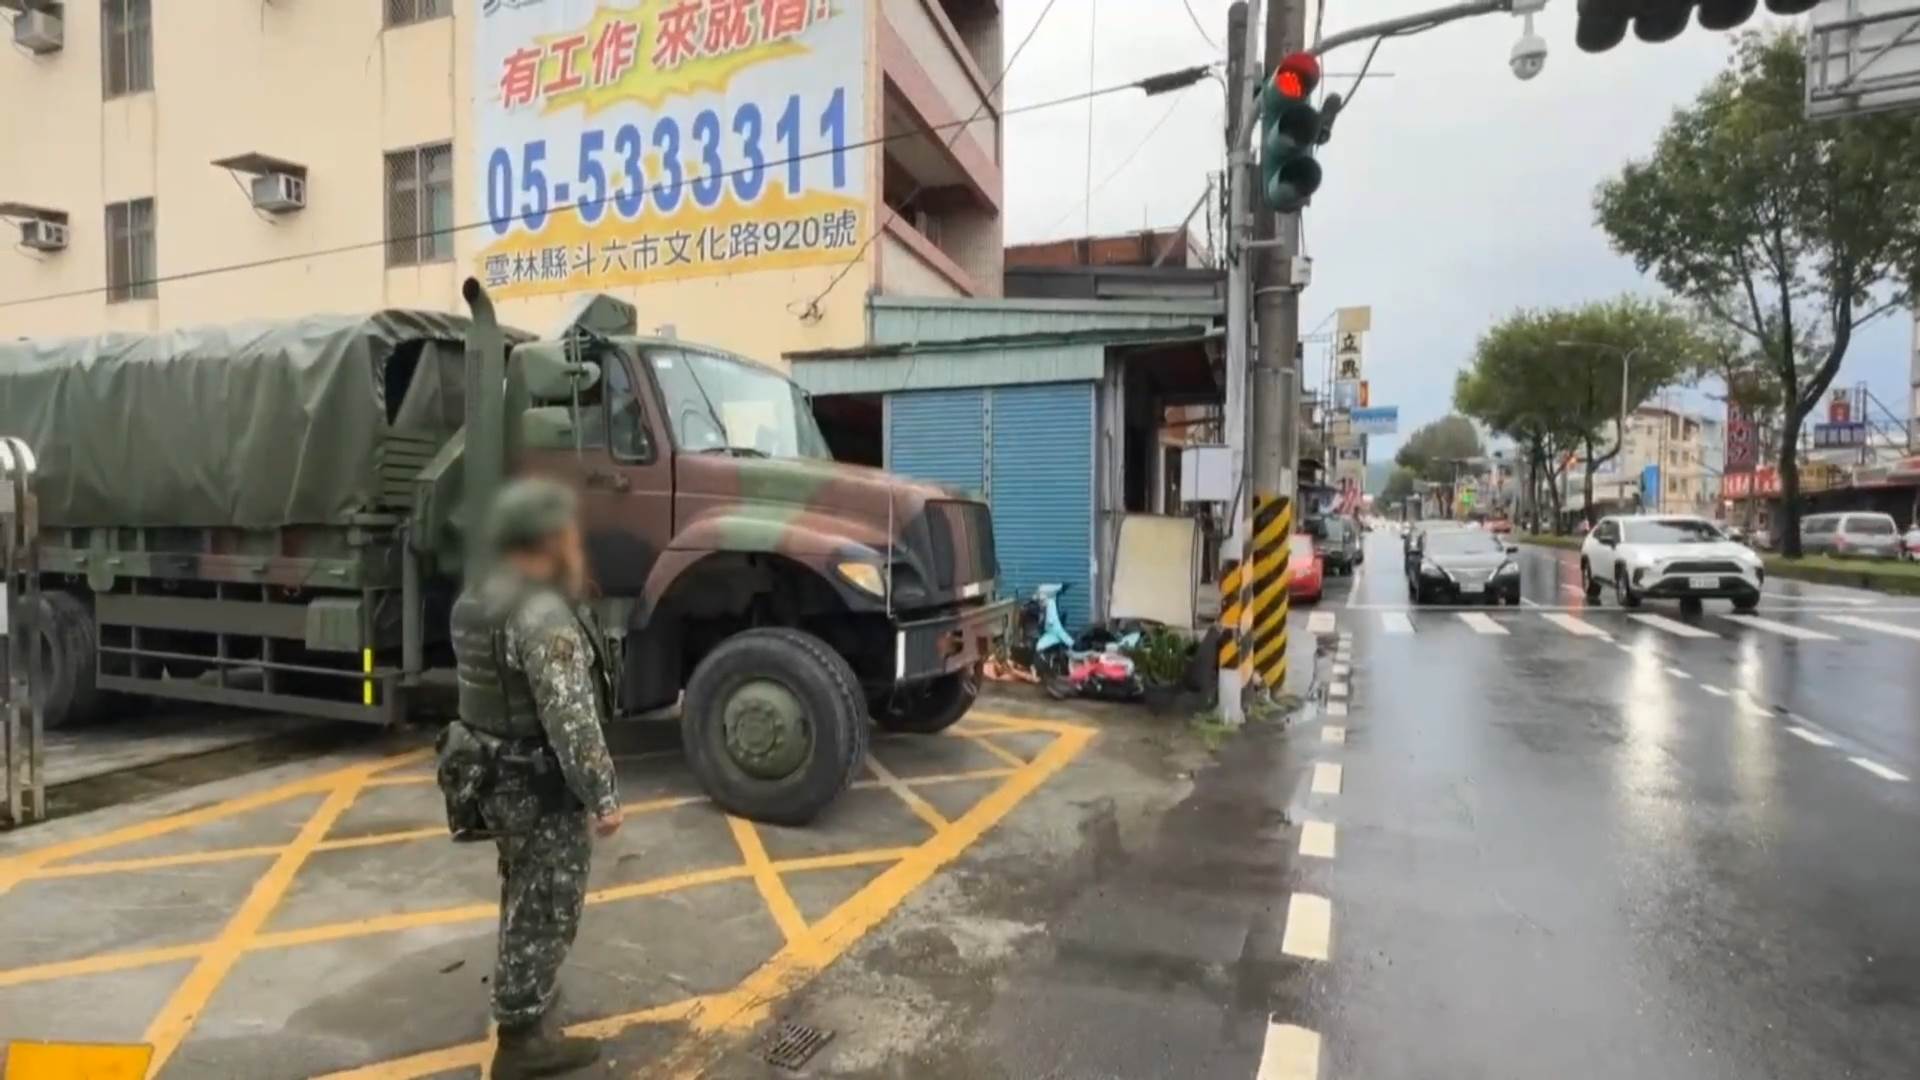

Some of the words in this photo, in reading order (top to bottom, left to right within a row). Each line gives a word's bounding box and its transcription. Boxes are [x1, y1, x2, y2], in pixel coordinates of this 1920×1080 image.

[500, 20, 638, 107] 有工作
[487, 87, 846, 234] 05-5333311
[485, 211, 857, 287] 雲林縣斗六市文化路920號
